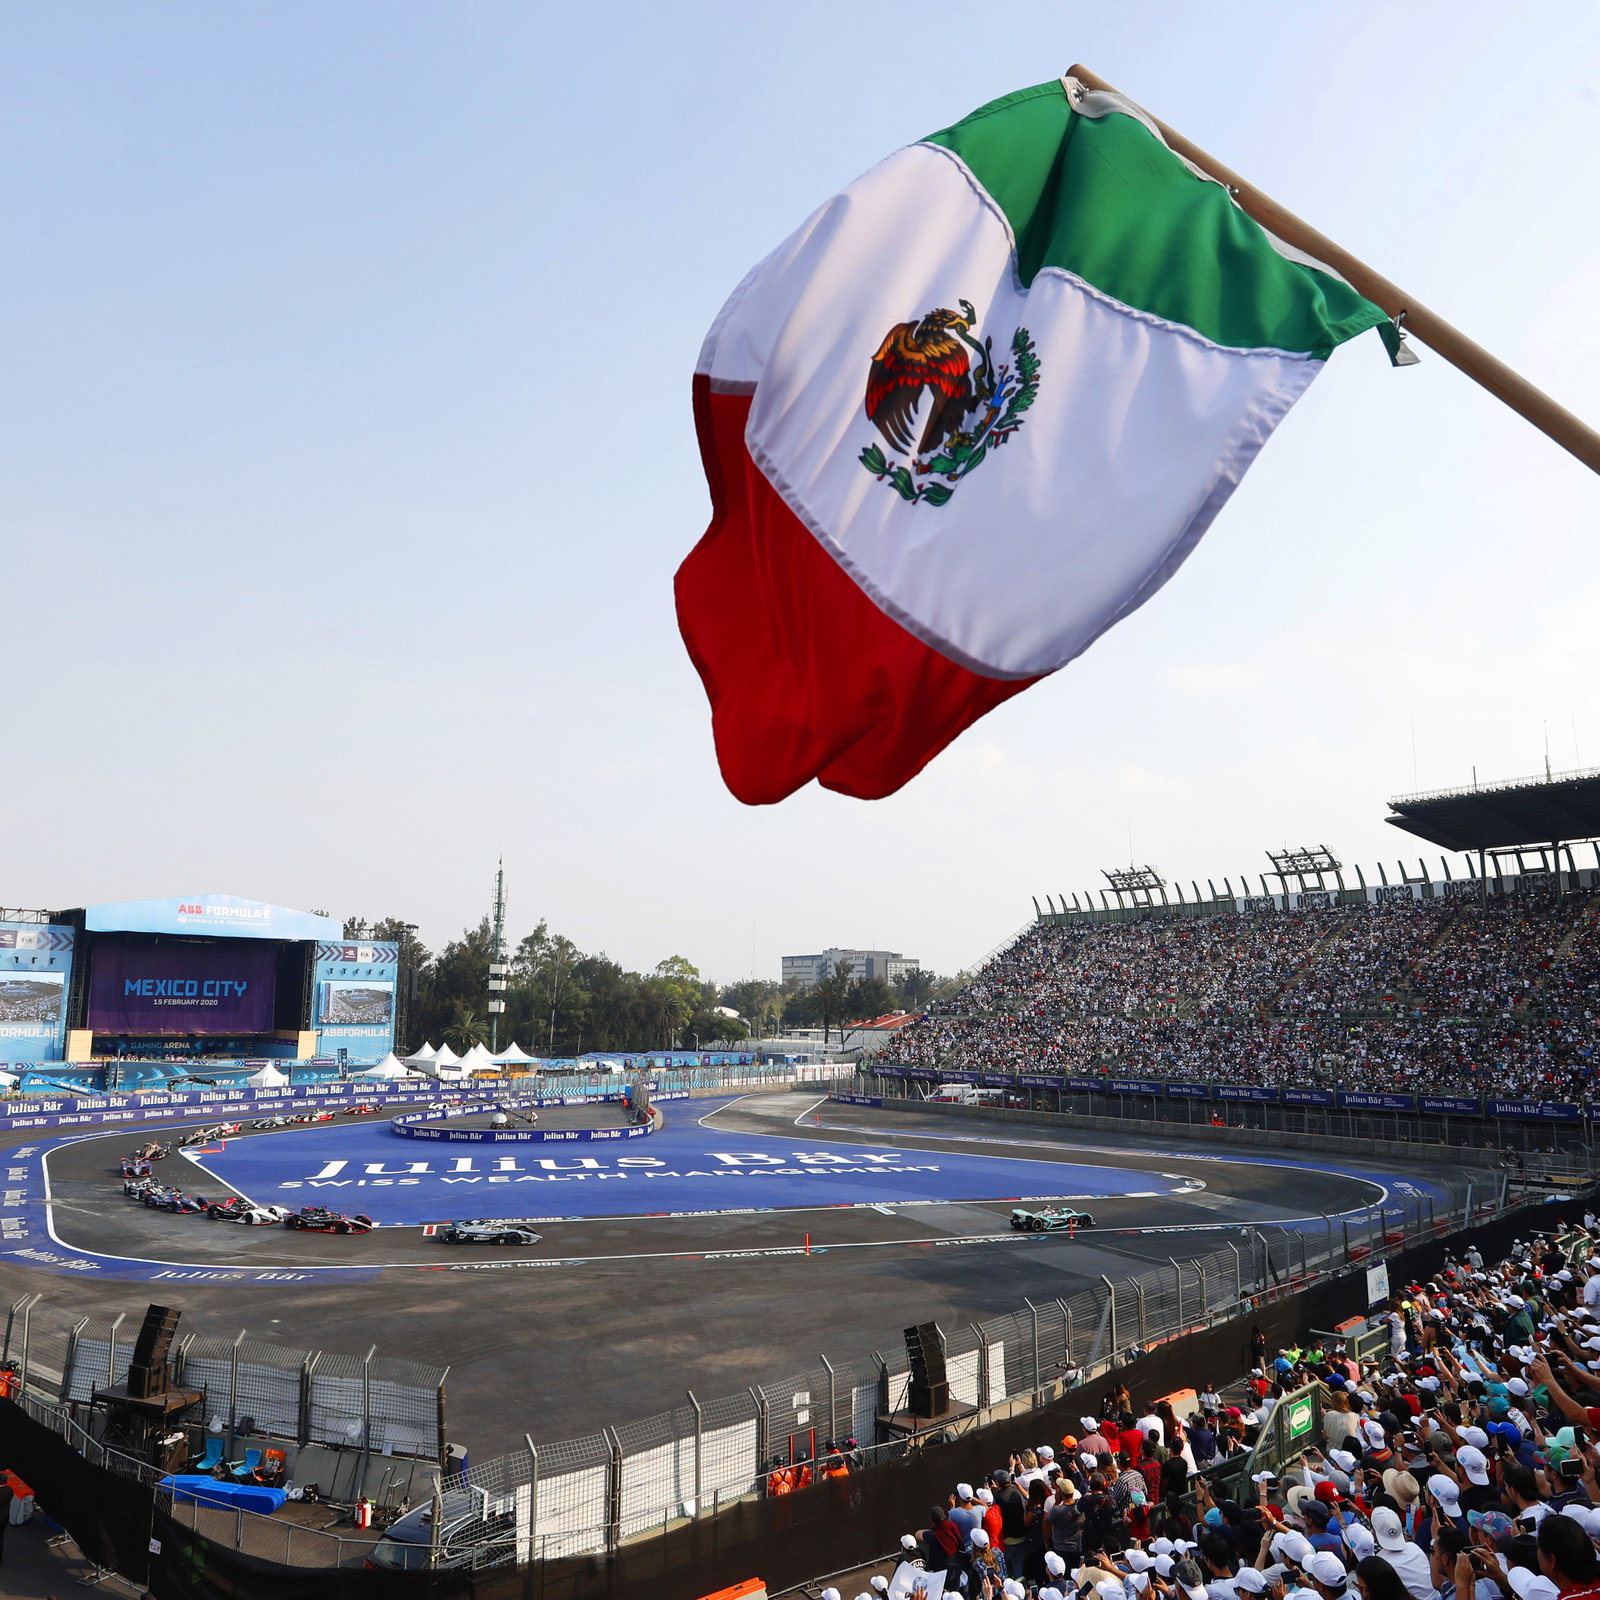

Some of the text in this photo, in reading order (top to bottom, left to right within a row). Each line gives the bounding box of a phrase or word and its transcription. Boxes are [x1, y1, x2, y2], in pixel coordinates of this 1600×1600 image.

[178, 904, 202, 914] ABB
[124, 979, 247, 997] MEXICO CITY
[0, 1028, 59, 1038] ORMULAE
[353, 1083, 390, 1094] Julius Bär
[398, 1082, 432, 1093] Julius Bär
[439, 1081, 458, 1091] Julius
[479, 1080, 497, 1089] Julius
[255, 1088, 297, 1100] Julius Bär
[306, 1085, 344, 1096] Julius Bär
[1239, 1089, 1251, 1097] Bär
[140, 1094, 189, 1107] Julius Bär
[200, 1090, 245, 1103] Julius Bär
[1345, 1095, 1366, 1104] Julius
[1368, 1096, 1382, 1104] Bär
[7, 1101, 64, 1116] Julius Bär
[76, 1097, 128, 1111] Julius Bär
[1496, 1104, 1540, 1114] Julius Bär
[184, 1108, 201, 1116] Julius
[12, 1118, 47, 1128] Julius Bär
[59, 1116, 79, 1124] Julius
[414, 1129, 429, 1137] Julius
[449, 1132, 468, 1140] Julius
[495, 1133, 516, 1141] Julius
[544, 1132, 565, 1141] Julius
[591, 1130, 621, 1140] Julius Bär
[305, 1152, 901, 1180] Julius Bär
[277, 1166, 941, 1189] SWISS WEALTH MANAGEMENT
[704, 1251, 761, 1259] ATTACK
[450, 1262, 513, 1270] ATTACK
[151, 1270, 313, 1280] Julius Bär
